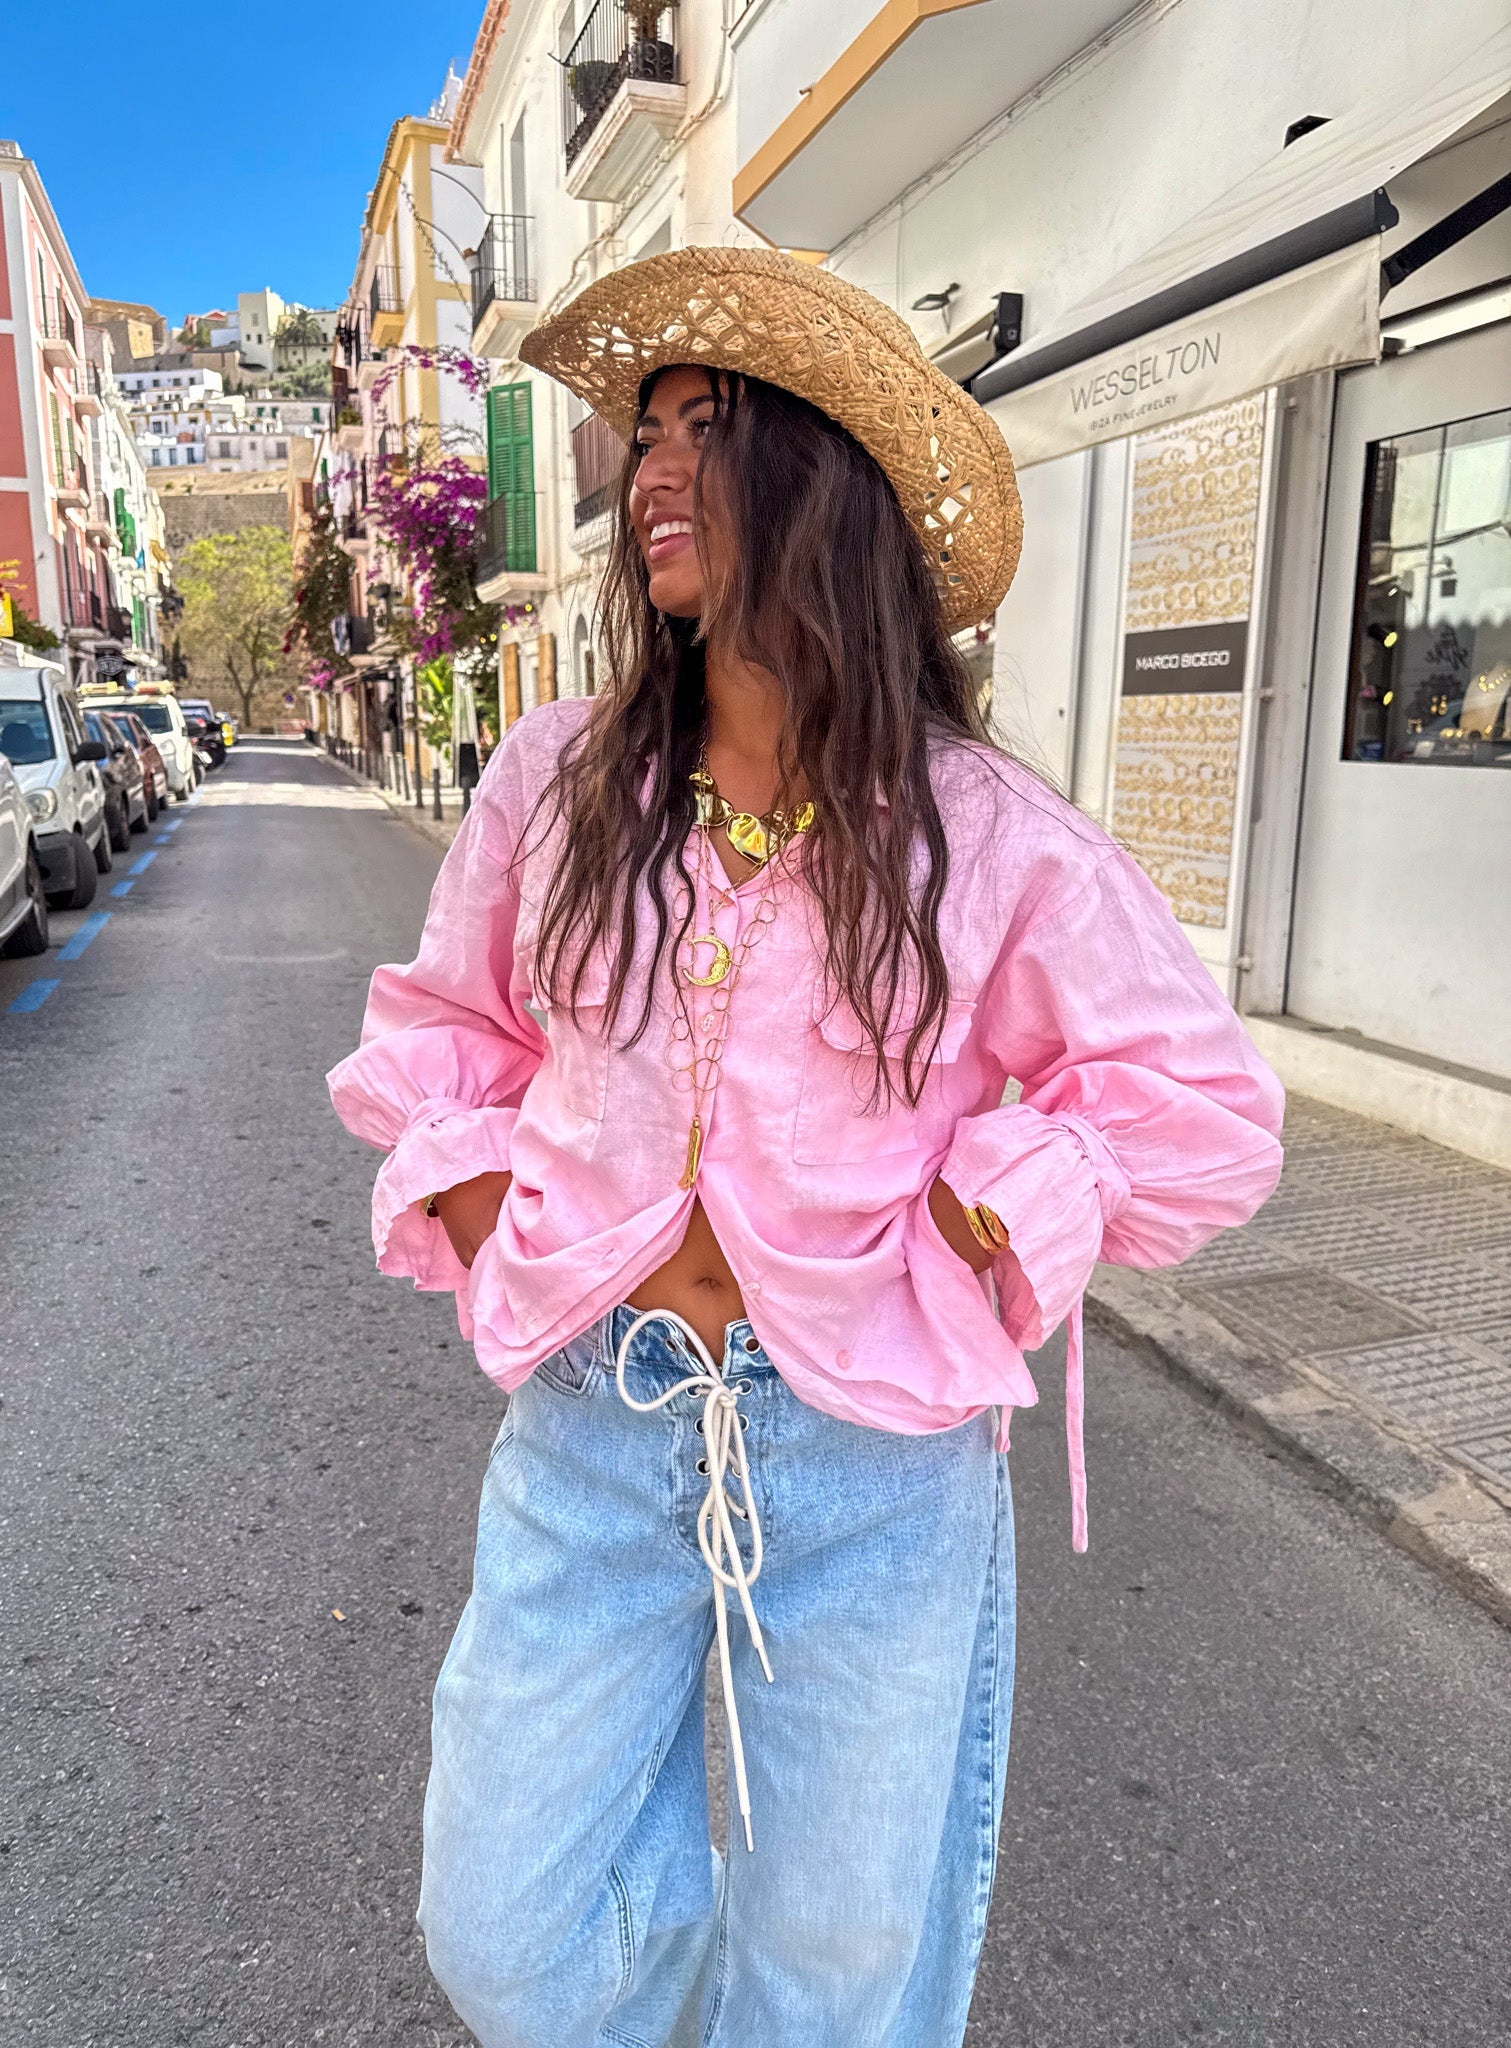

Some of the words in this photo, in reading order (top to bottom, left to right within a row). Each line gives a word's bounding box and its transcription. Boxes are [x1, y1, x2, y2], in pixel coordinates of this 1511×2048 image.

[1070, 332, 1221, 414] WESSELTON
[1112, 408, 1136, 424] FINE
[1135, 654, 1179, 670] MARCO
[1181, 650, 1230, 668] BICEGO
